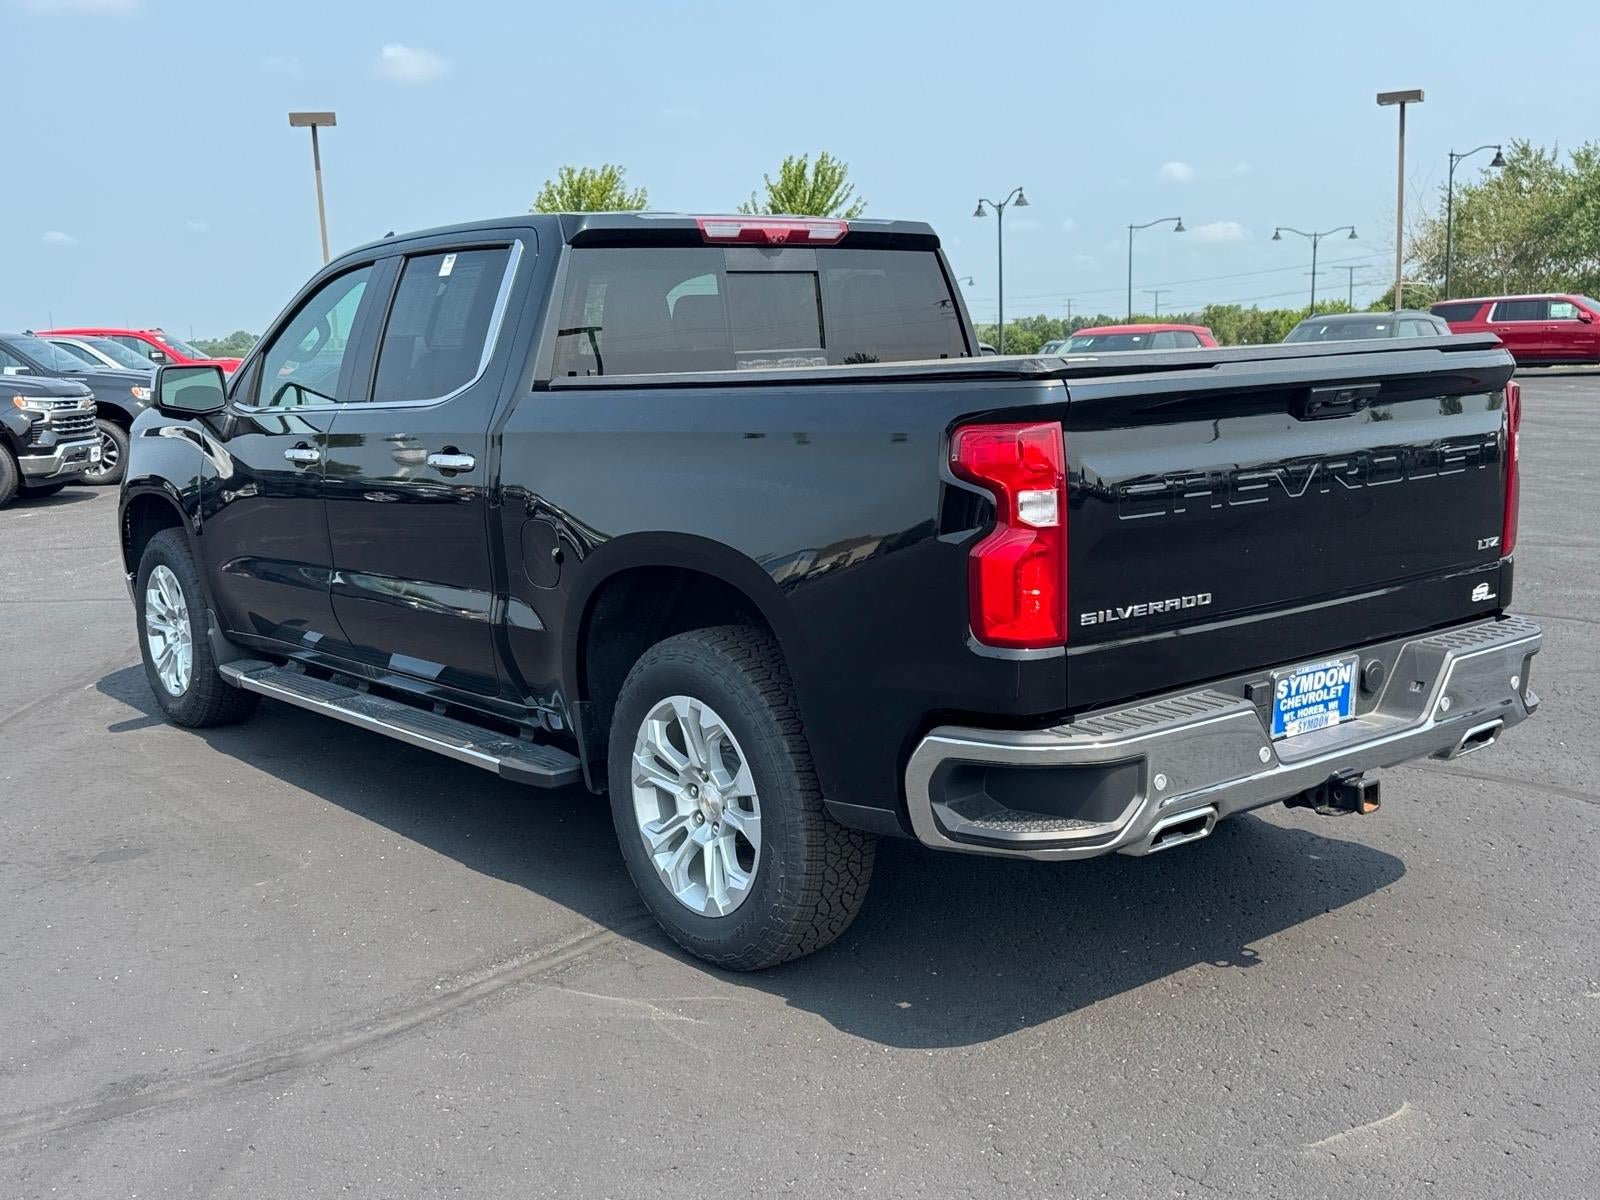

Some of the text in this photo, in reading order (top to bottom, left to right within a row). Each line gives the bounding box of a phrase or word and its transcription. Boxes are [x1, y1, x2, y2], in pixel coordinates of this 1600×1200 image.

[1118, 439, 1499, 520] CHEVROLET
[1477, 536, 1500, 551] LTZ
[1080, 592, 1212, 626] SILVERADO
[1277, 664, 1352, 699] SYMDON
[1279, 685, 1345, 711] CHEVROLET
[1296, 714, 1330, 733] SYMDON
